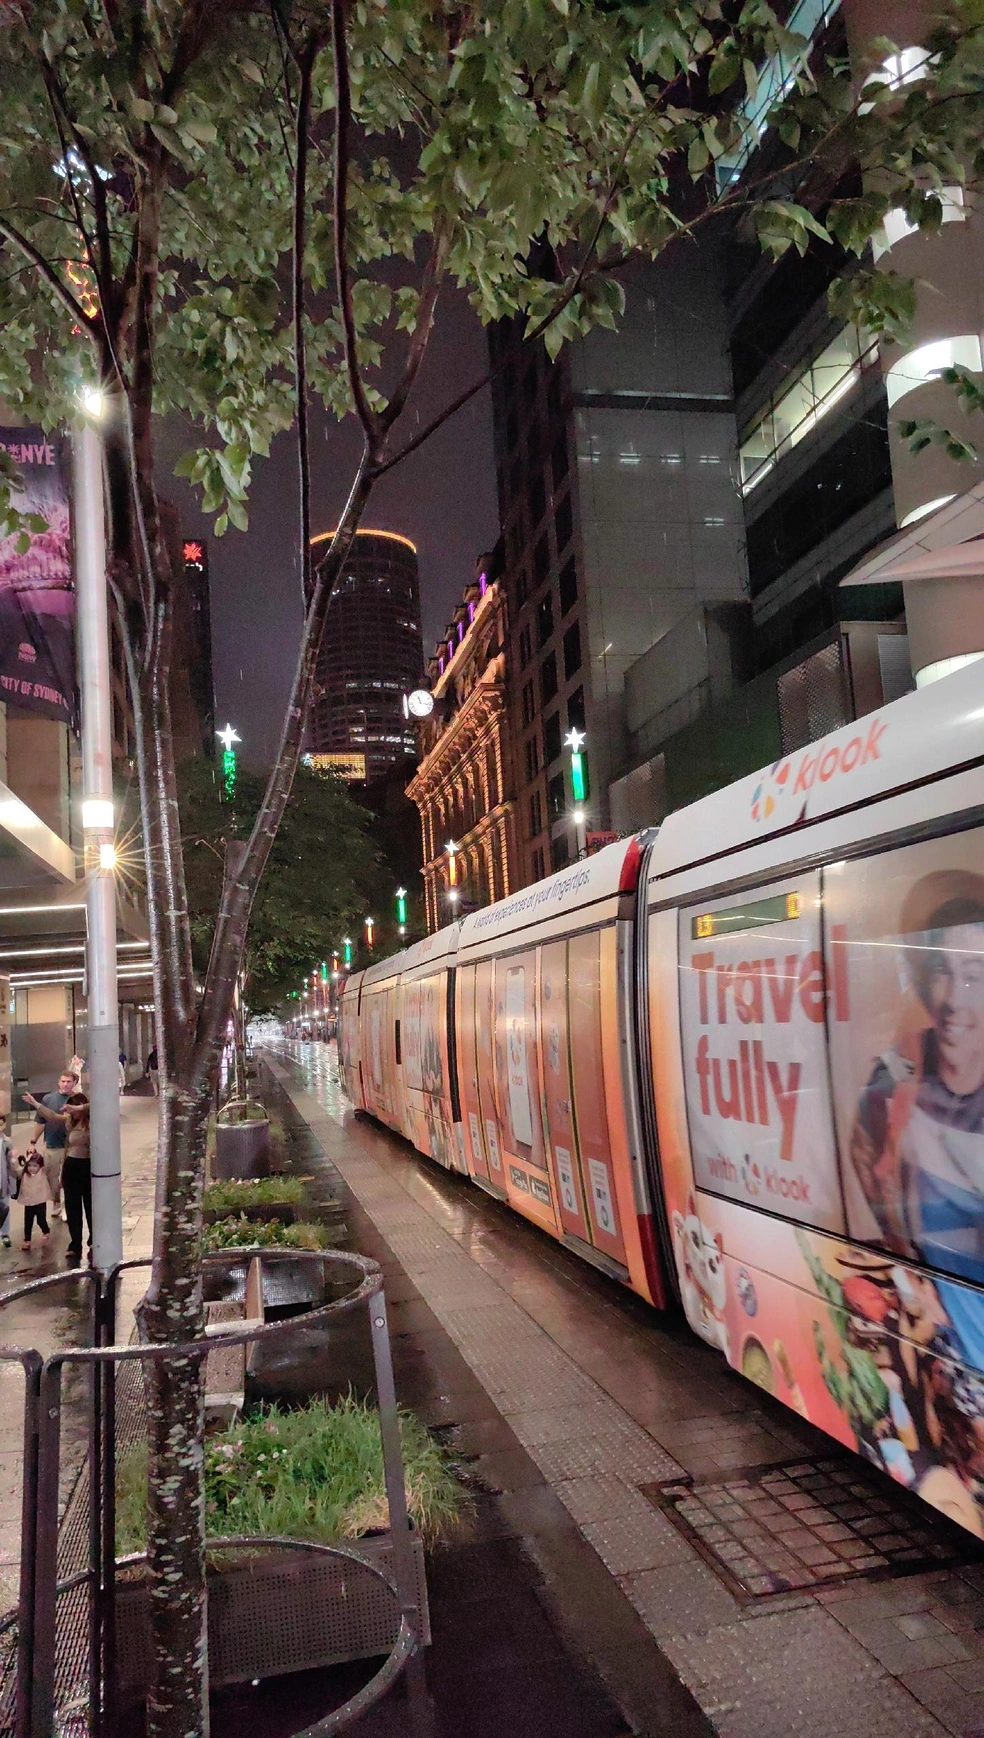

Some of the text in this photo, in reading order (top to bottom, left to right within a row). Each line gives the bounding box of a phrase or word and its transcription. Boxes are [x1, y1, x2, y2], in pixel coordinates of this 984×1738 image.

[21, 444, 55, 465] NYE
[21, 681, 33, 695] OF
[33, 683, 63, 704] SYDNEY
[792, 716, 890, 796] klook
[533, 887, 552, 912] your
[550, 868, 591, 901] fingertips.
[692, 923, 850, 1025] Travel
[697, 1034, 802, 1161] fully
[707, 1153, 813, 1205] with klook
